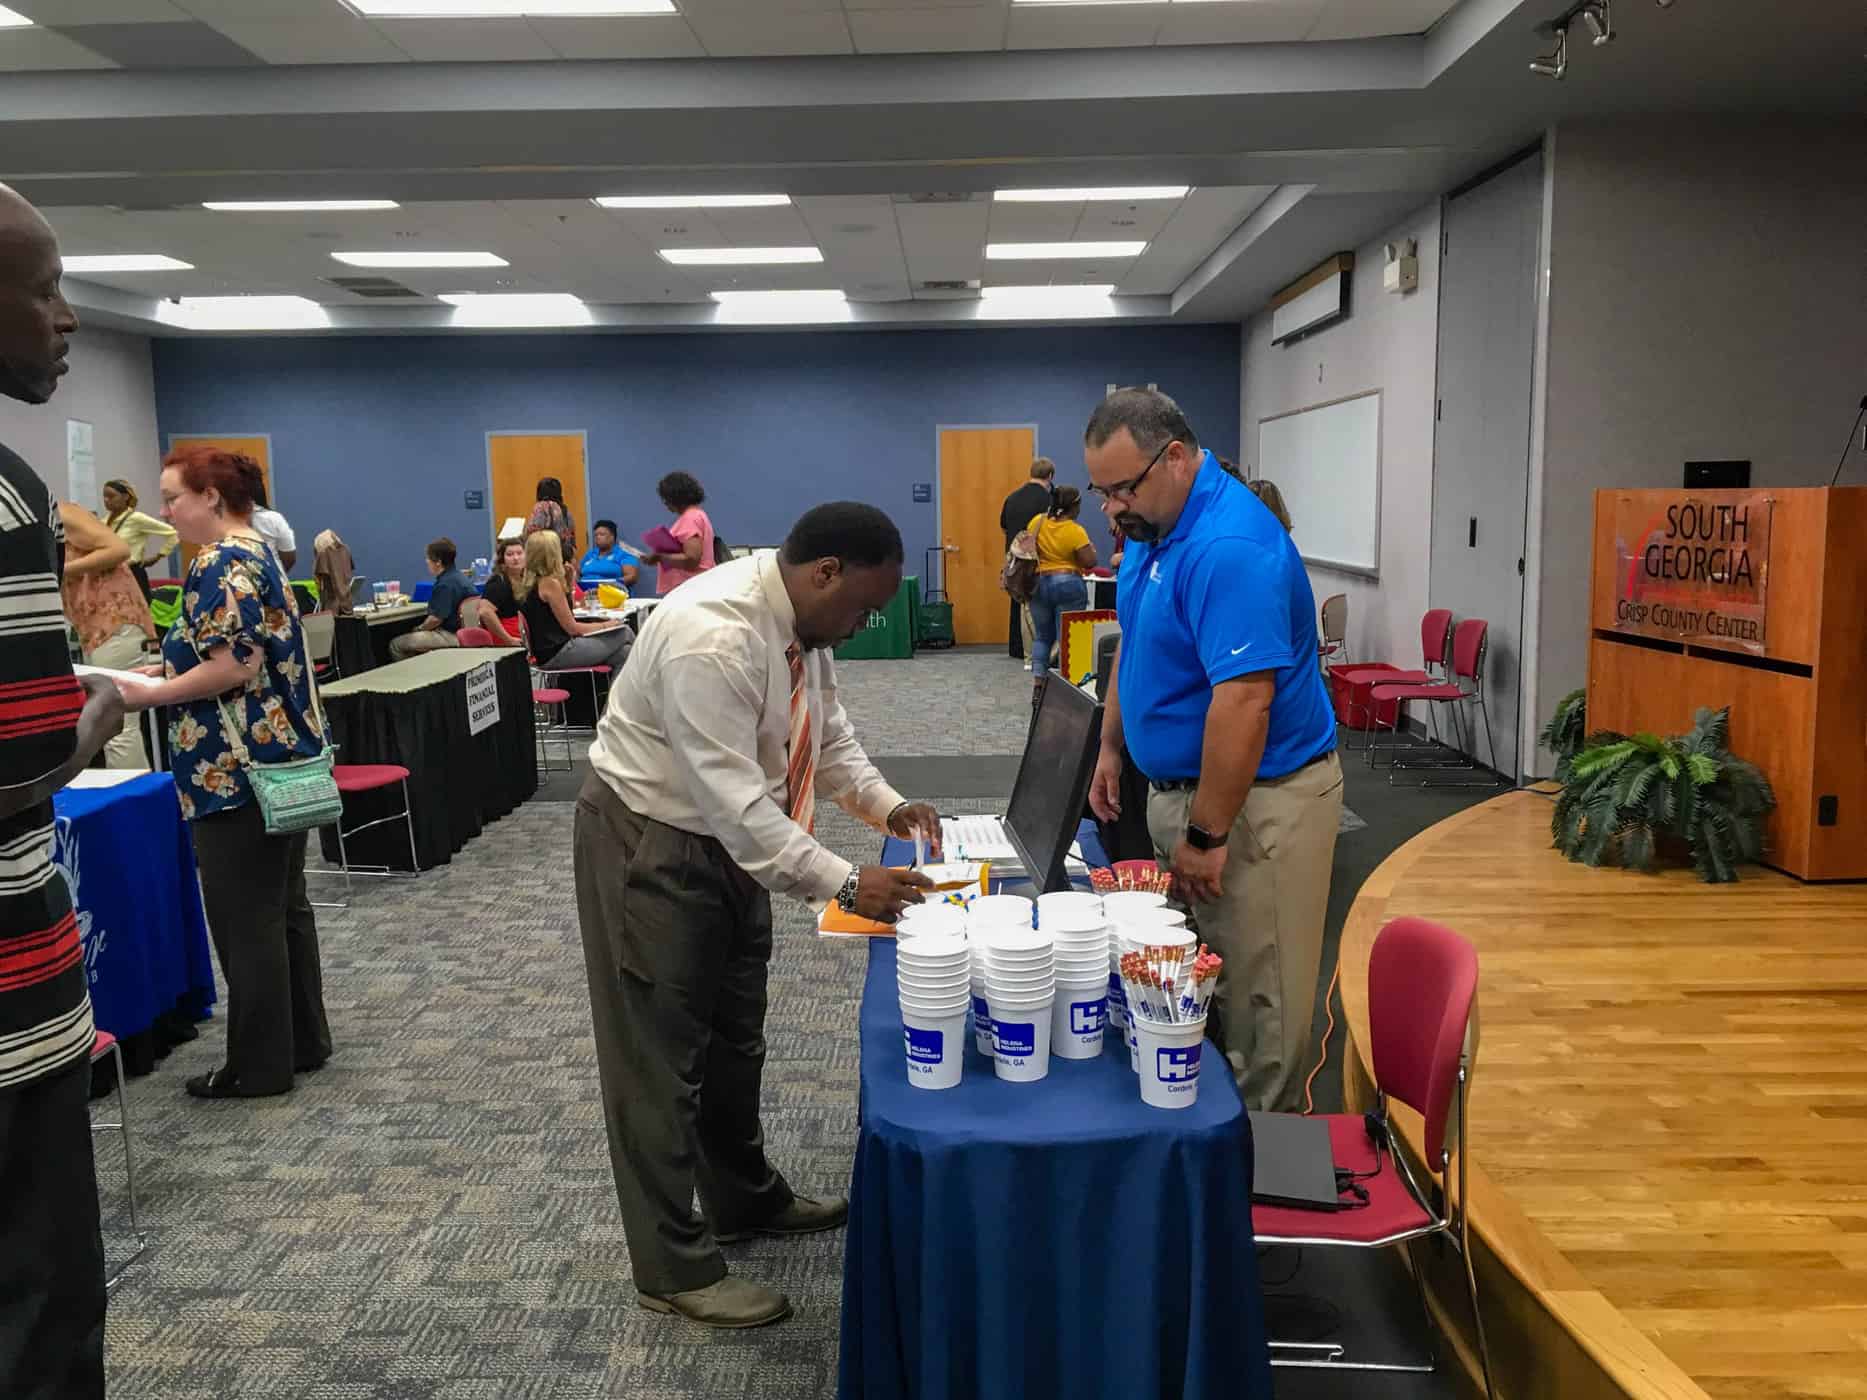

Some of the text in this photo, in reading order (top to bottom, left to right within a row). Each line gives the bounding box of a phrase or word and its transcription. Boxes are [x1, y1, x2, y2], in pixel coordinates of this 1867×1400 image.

[1665, 504, 1750, 543] SOUTH
[1645, 544, 1754, 587] GEORGIA
[1617, 599, 1759, 642] CRISP COUNTY CENTER
